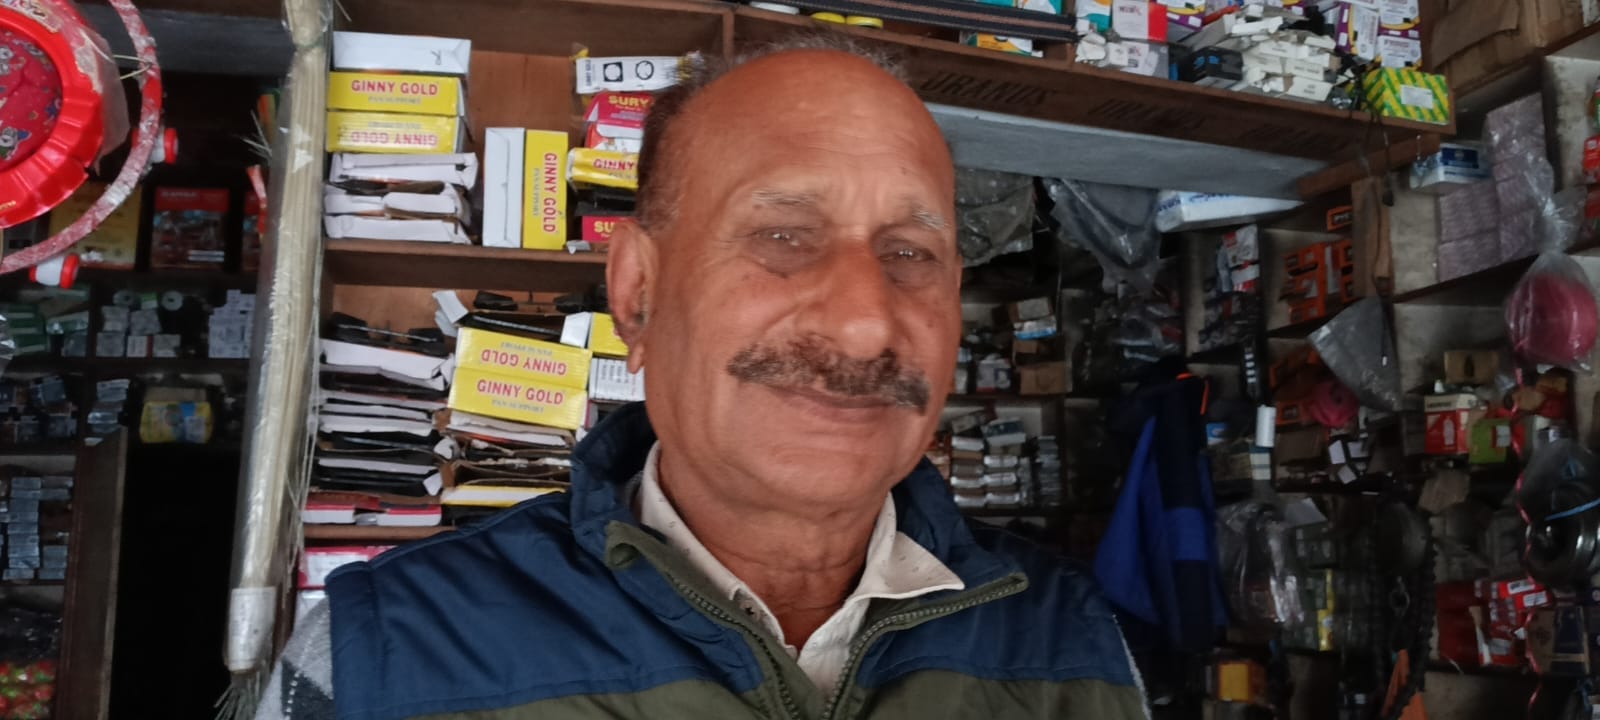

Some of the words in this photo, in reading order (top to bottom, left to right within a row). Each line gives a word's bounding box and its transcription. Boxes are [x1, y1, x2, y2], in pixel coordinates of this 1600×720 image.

[351, 80, 396, 93] GINNY
[400, 82, 439, 96] GOLD
[608, 95, 652, 108] SURY
[350, 131, 389, 143] GOLD
[394, 132, 438, 146] GINNY
[544, 152, 558, 193] GINNY
[593, 158, 635, 171] GINNY
[543, 197, 557, 233] GOLD
[594, 220, 616, 234] SU
[481, 348, 520, 367] GOLD
[523, 358, 568, 376] GINNY
[477, 379, 521, 398] GINNY
[526, 387, 564, 405] GOLD
